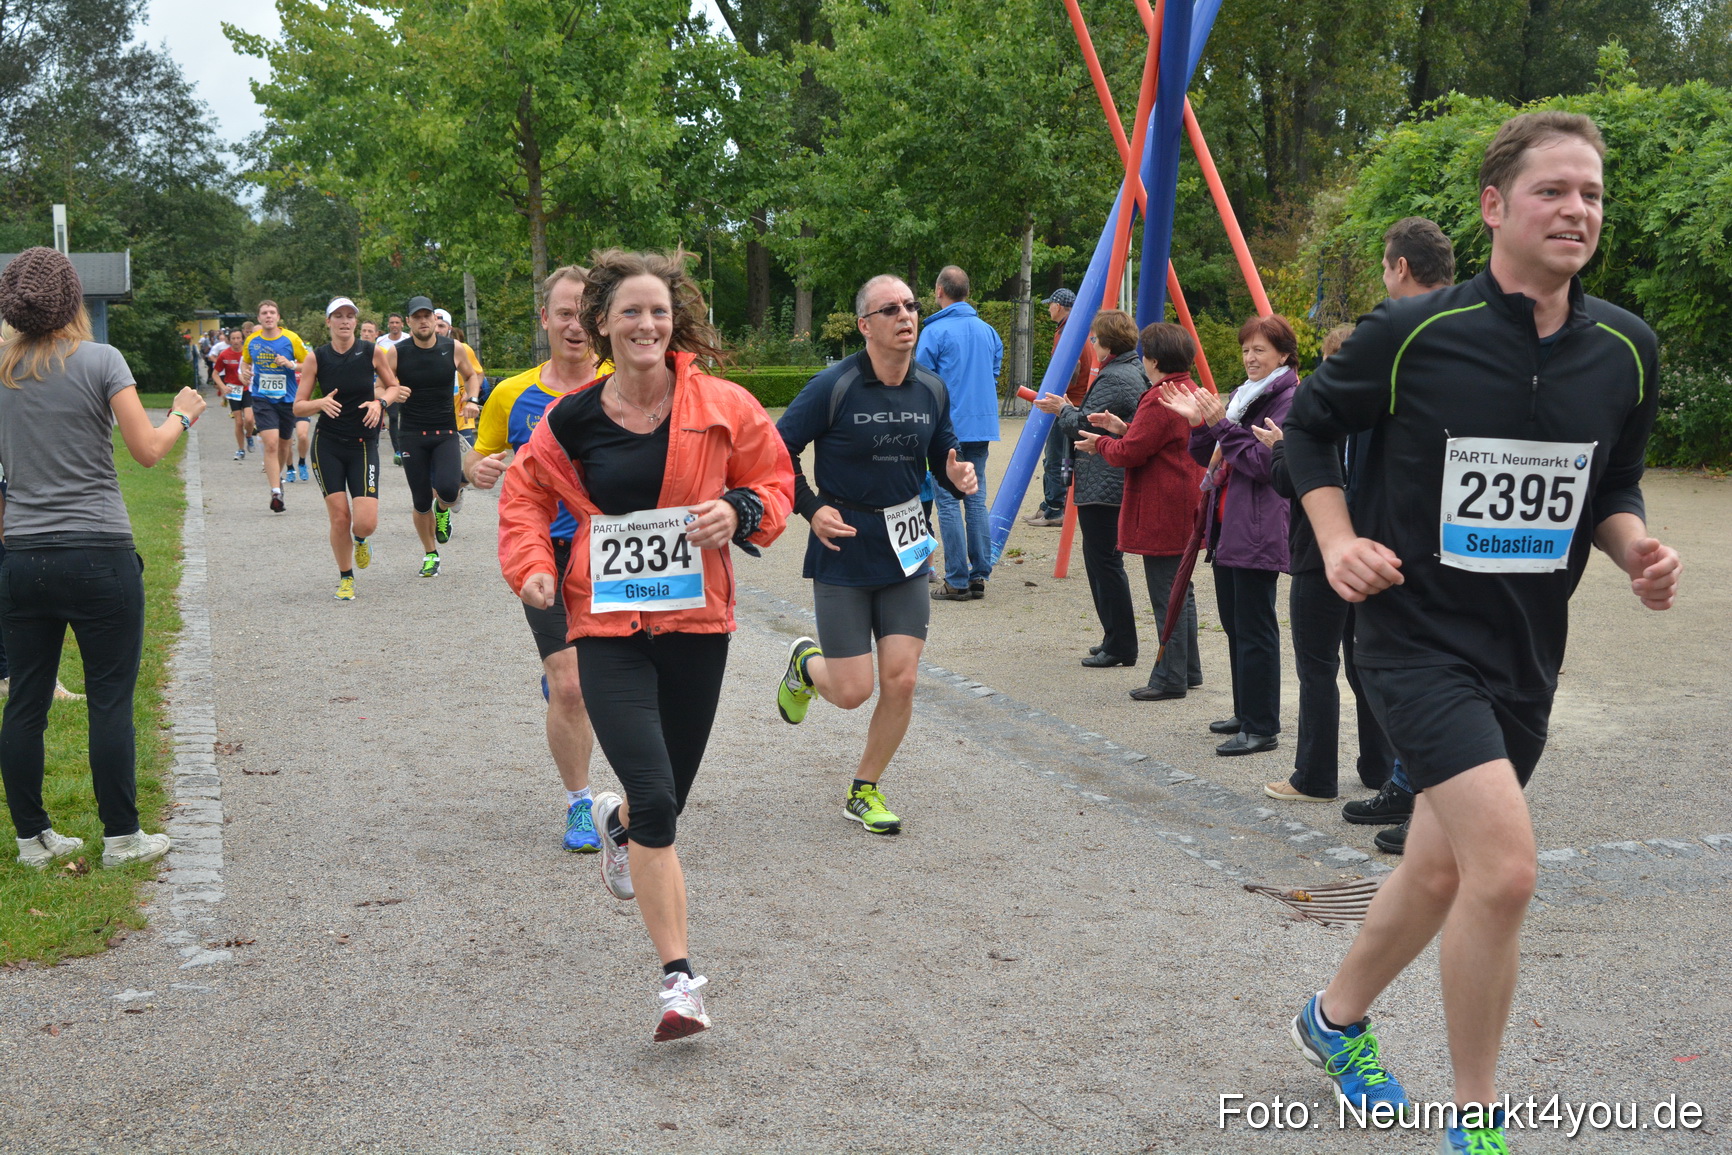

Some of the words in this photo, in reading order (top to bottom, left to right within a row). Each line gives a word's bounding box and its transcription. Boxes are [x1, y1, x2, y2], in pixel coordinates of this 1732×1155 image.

[262, 379, 284, 390] 2765
[853, 411, 930, 425] DELPHI
[873, 433, 919, 449] SPORTS
[872, 454, 899, 463] Running
[1449, 449, 1498, 465] PARTL
[1502, 452, 1569, 468] Neumarkt
[1457, 470, 1576, 523] 2395
[887, 510, 908, 521] PARTL
[593, 523, 625, 534] PARTL
[628, 518, 680, 531] Neumarkt
[1466, 533, 1555, 554] Sebastian
[602, 532, 692, 575] 2334
[625, 582, 670, 599] Gisela
